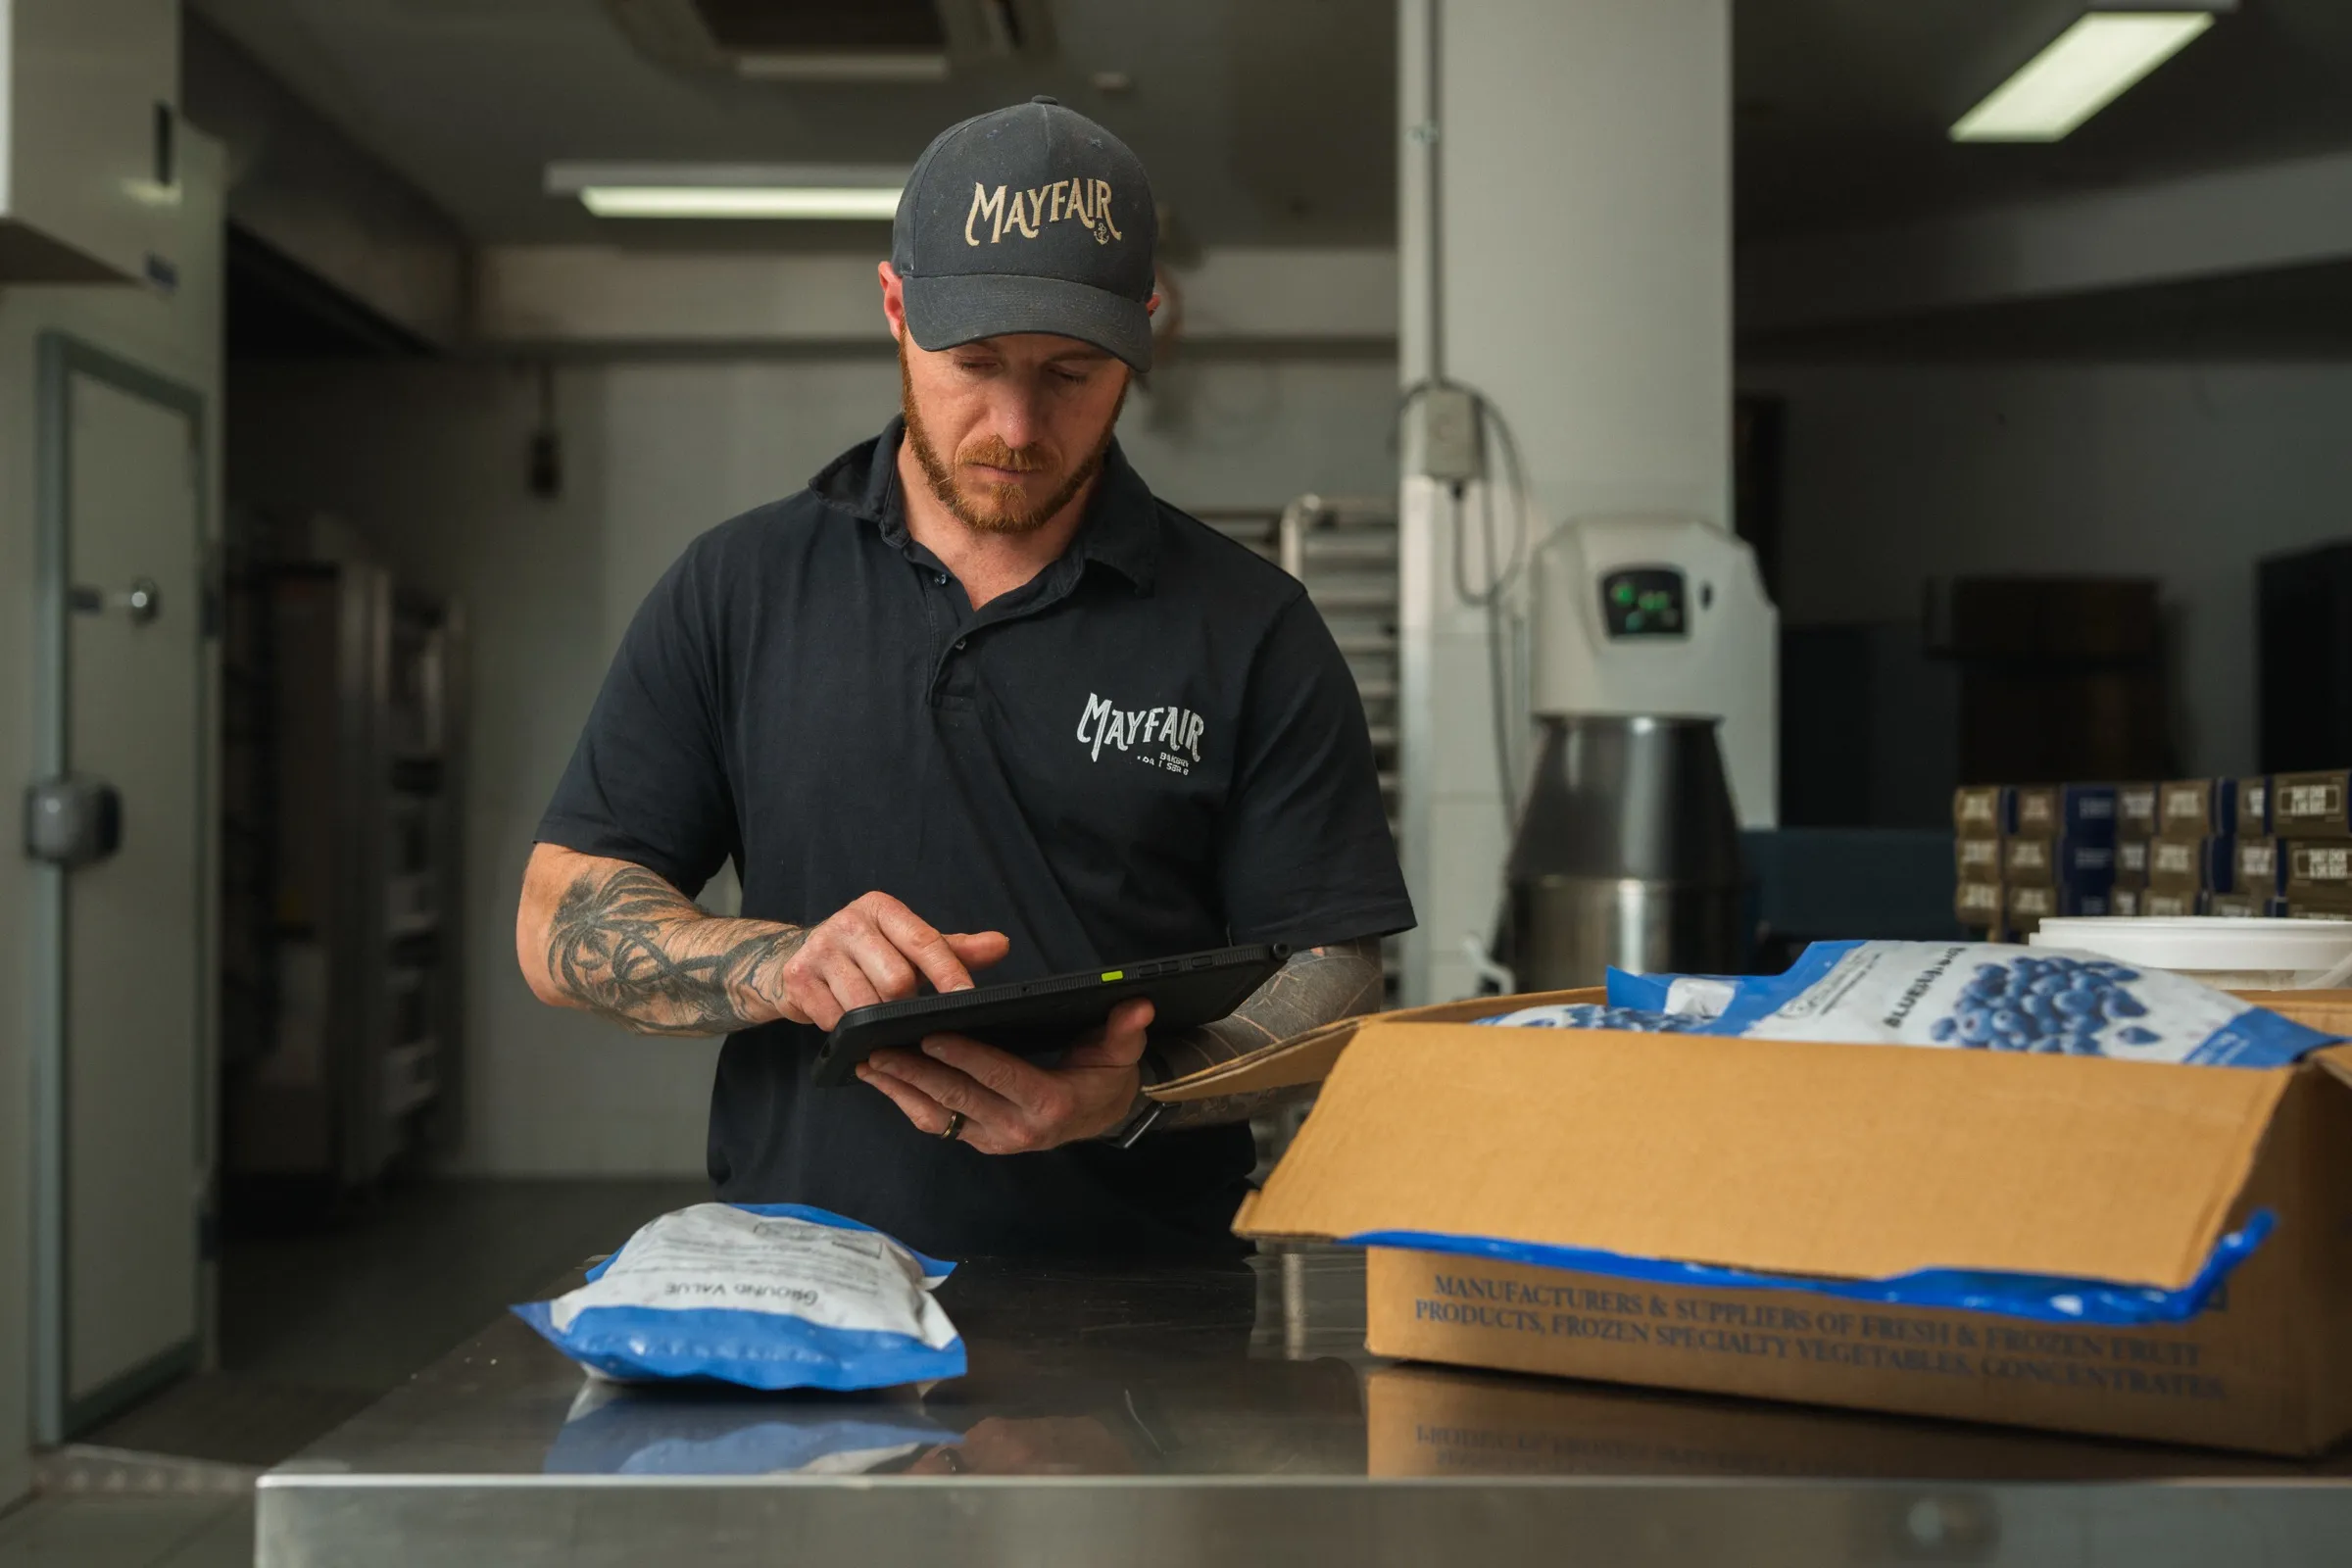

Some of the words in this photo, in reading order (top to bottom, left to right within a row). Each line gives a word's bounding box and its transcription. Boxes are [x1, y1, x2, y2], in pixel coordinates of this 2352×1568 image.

[964, 177, 1122, 246] MAYFAIR
[1076, 692, 1204, 762] MAYFAIR
[663, 1280, 727, 1298] VALUE
[1434, 1274, 1643, 1315] MANUFACTURERS
[1649, 1295, 1669, 1317] &
[1676, 1298, 1812, 1331] SUPPLIERS
[1815, 1310, 1854, 1337] OF
[1861, 1315, 1950, 1346] FRESH
[1985, 1327, 2105, 1356] FROZEN
[2110, 1337, 2201, 1367] FRUIT
[1414, 1298, 1546, 1336] PRODUCTS,
[1551, 1313, 1649, 1343] FROZEN
[1655, 1324, 1791, 1359] SPECIALTY
